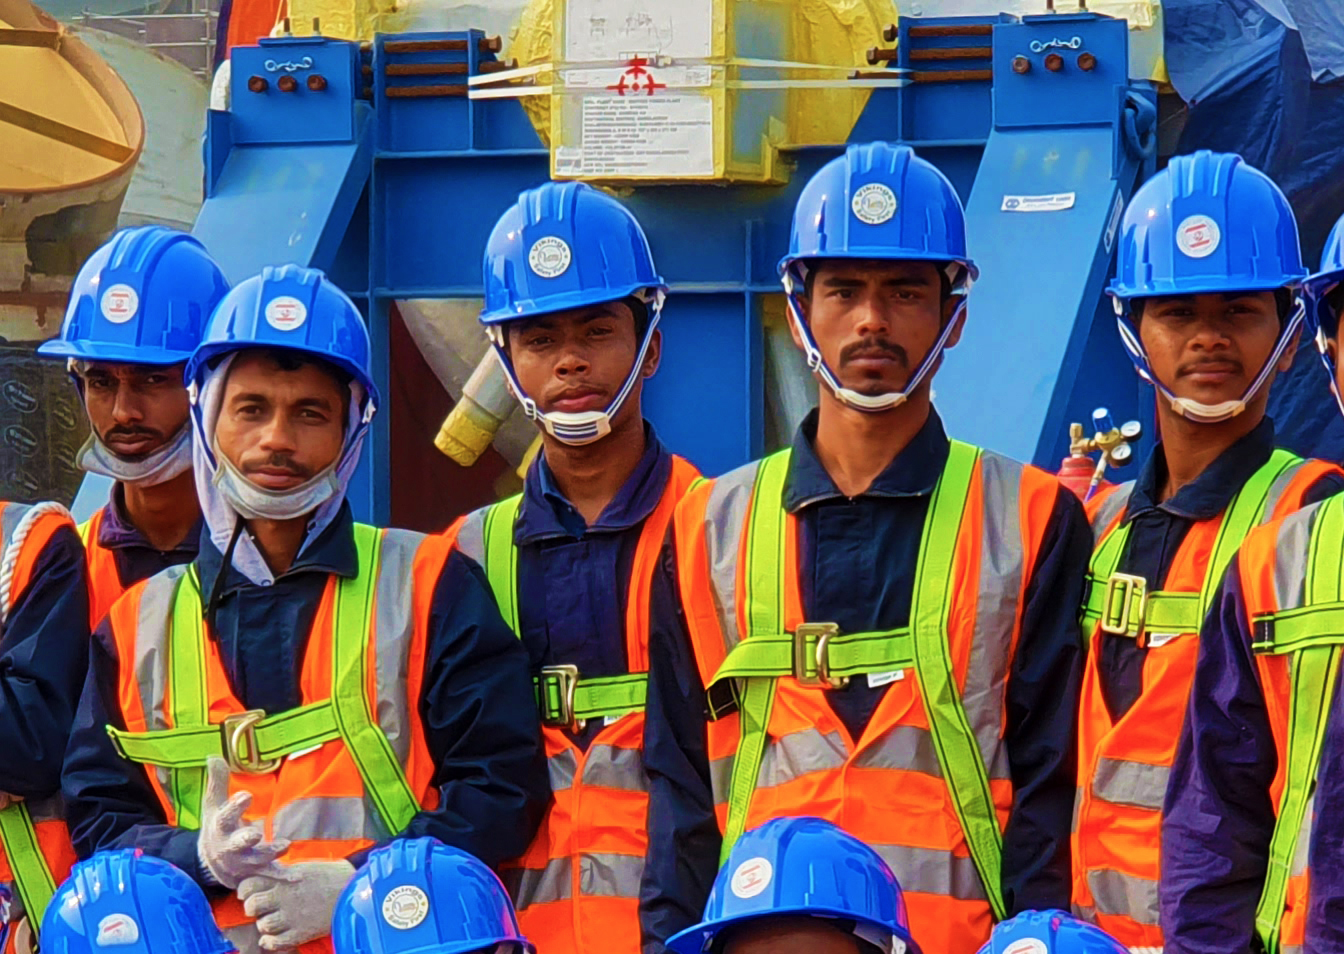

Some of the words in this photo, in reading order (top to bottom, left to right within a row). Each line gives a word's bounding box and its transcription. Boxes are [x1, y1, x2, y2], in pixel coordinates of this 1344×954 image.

[855, 185, 893, 200] Vikings
[532, 238, 567, 252] Vikings
[385, 887, 424, 902] Vikings
